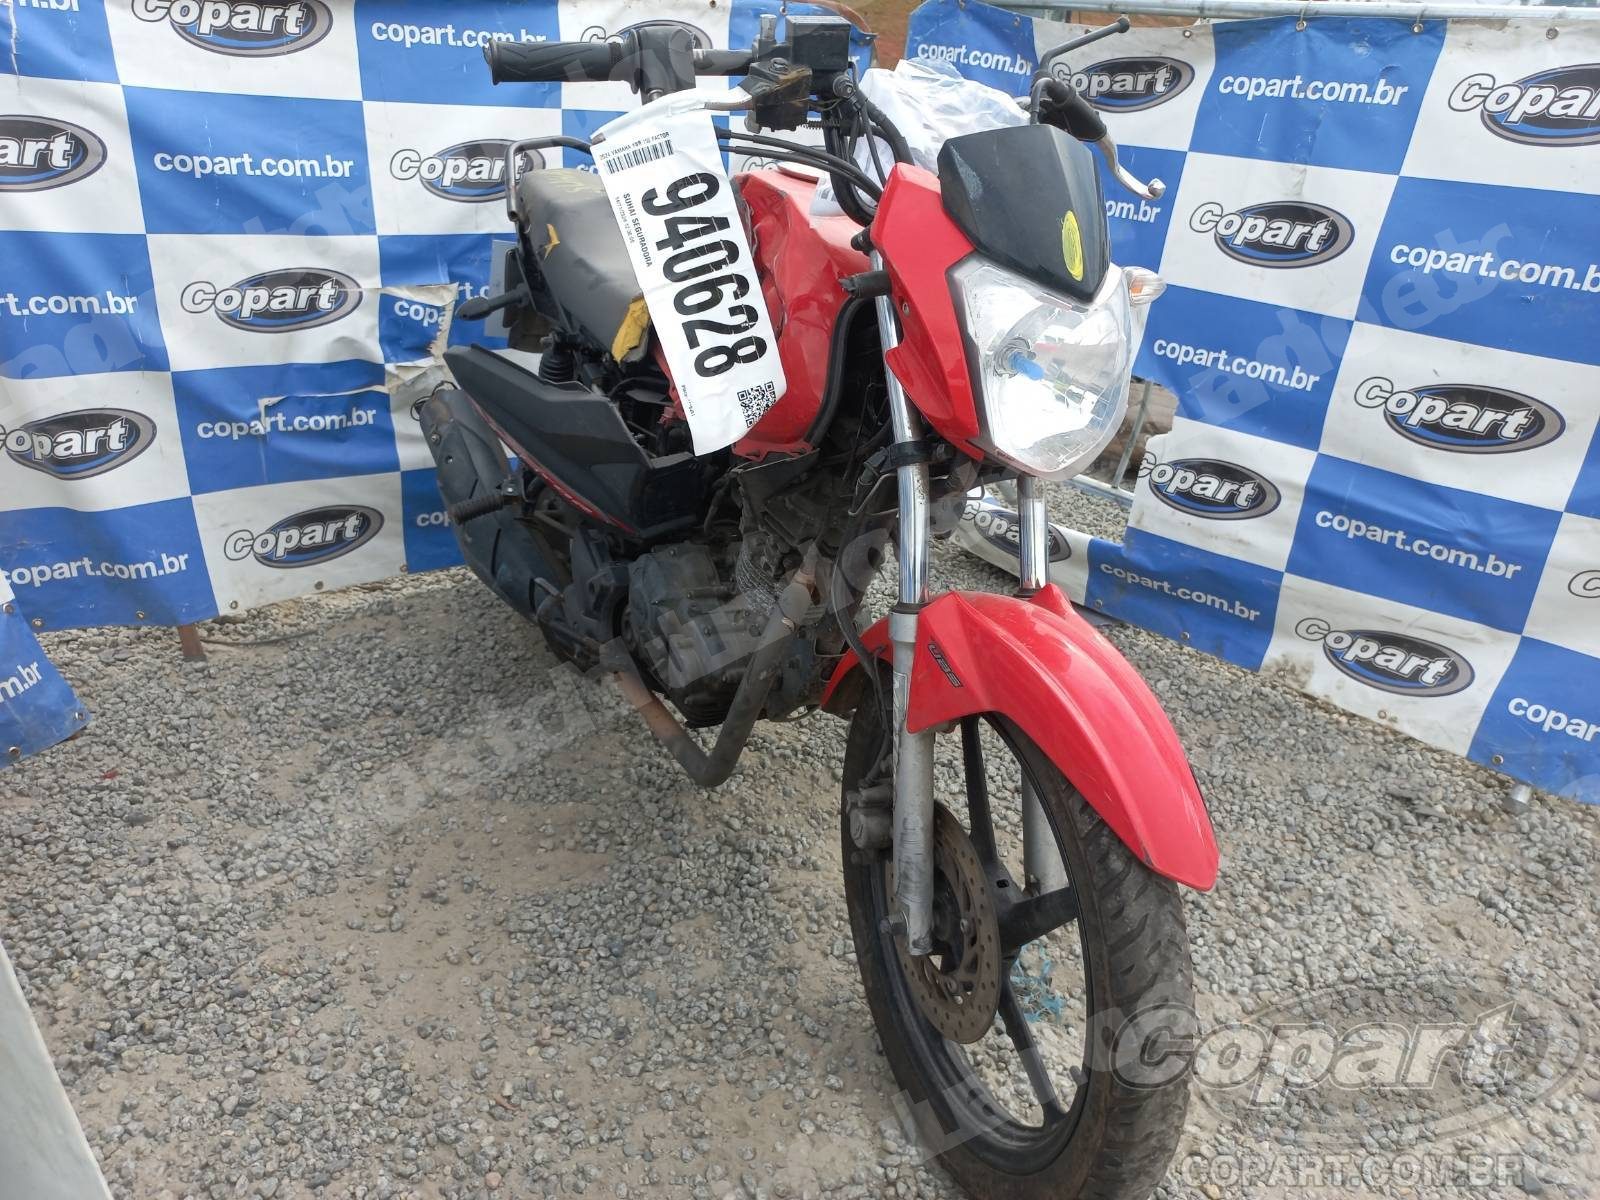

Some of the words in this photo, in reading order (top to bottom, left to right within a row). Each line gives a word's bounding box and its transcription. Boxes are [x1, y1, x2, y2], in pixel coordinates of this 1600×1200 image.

[131, 0, 307, 36] Copart
[1218, 74, 1408, 106] copart.com.br
[153, 152, 354, 178] copart.com.br
[623, 192, 637, 217] SUHAI
[631, 217, 653, 267] SEGURADORA
[1189, 201, 1334, 254] Copart
[180, 277, 339, 319] Copart
[641, 171, 768, 378] 940628
[0, 290, 138, 316] t.com.br
[1152, 336, 1321, 393] copart.com.br
[197, 406, 377, 441] copart.com.br
[1354, 376, 1536, 441] Copart
[0, 416, 129, 462] opart
[224, 511, 363, 563] Copart
[1314, 509, 1522, 580] copart.com.br
[1100, 563, 1261, 622] copart.com.br
[1294, 617, 1459, 689] Copart
